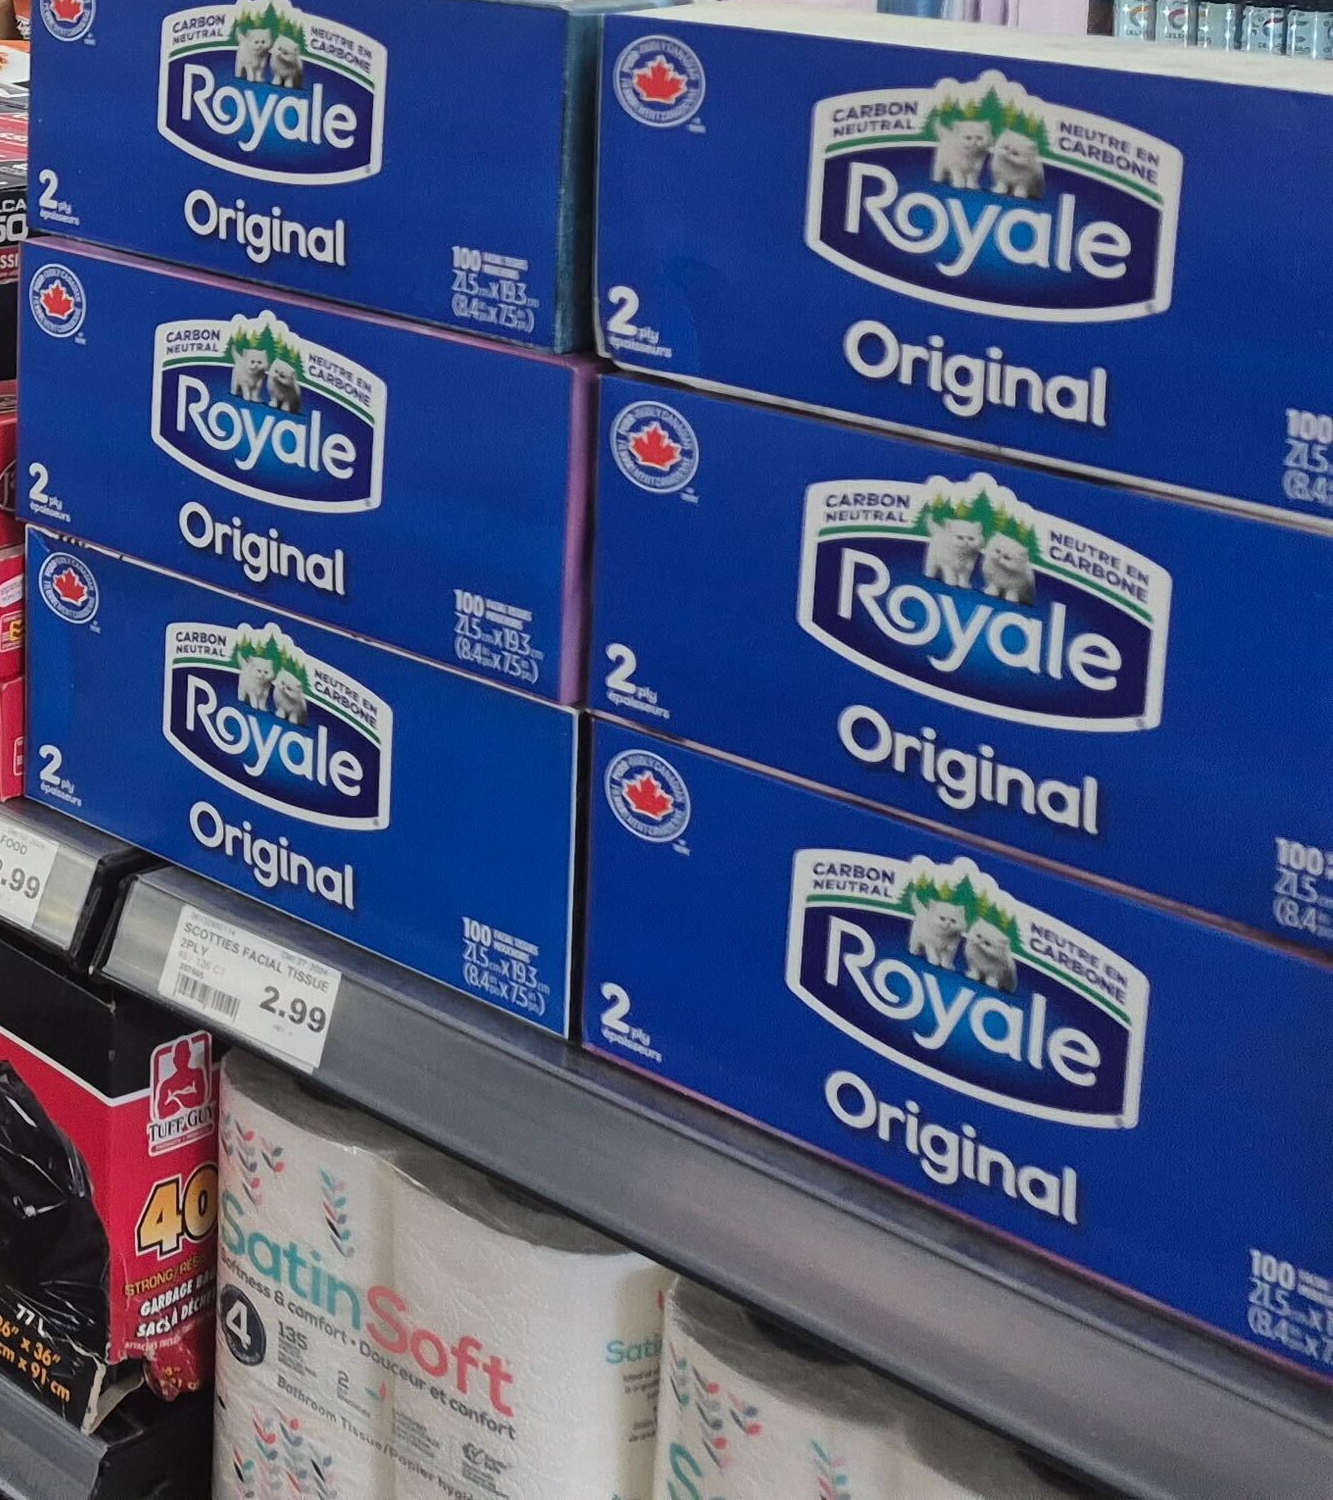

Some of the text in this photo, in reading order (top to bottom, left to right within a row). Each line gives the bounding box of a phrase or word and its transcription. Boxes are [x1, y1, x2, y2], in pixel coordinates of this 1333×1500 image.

[171, 13, 227, 33] CARBON
[172, 28, 225, 46] NEUTRAL
[181, 62, 359, 153] Royale
[831, 100, 920, 124] CARBON
[832, 116, 918, 139] NEUTRAL
[1058, 119, 1161, 168] NEUTRE EN
[38, 168, 59, 211] 2
[1056, 134, 1159, 186] CARBONE
[183, 188, 347, 268] Original
[844, 161, 1134, 280] Royale
[843, 318, 1109, 429] Original
[176, 374, 357, 481] Royale
[177, 500, 346, 597] Original
[837, 547, 1123, 693] Royale
[38, 744, 60, 785] 2
[185, 673, 364, 798] Royale
[837, 703, 1101, 837] Original
[0, 834, 29, 856] FOOD
[188, 799, 356, 911] Original
[180, 937, 210, 958] 2PLY
[183, 922, 331, 994] SCOTTIES FACIAL TISSUE
[258, 984, 327, 1034] 2.99
[824, 915, 1103, 1088] Royale
[824, 1069, 1080, 1226] Original
[1250, 1248, 1298, 1288] 100
